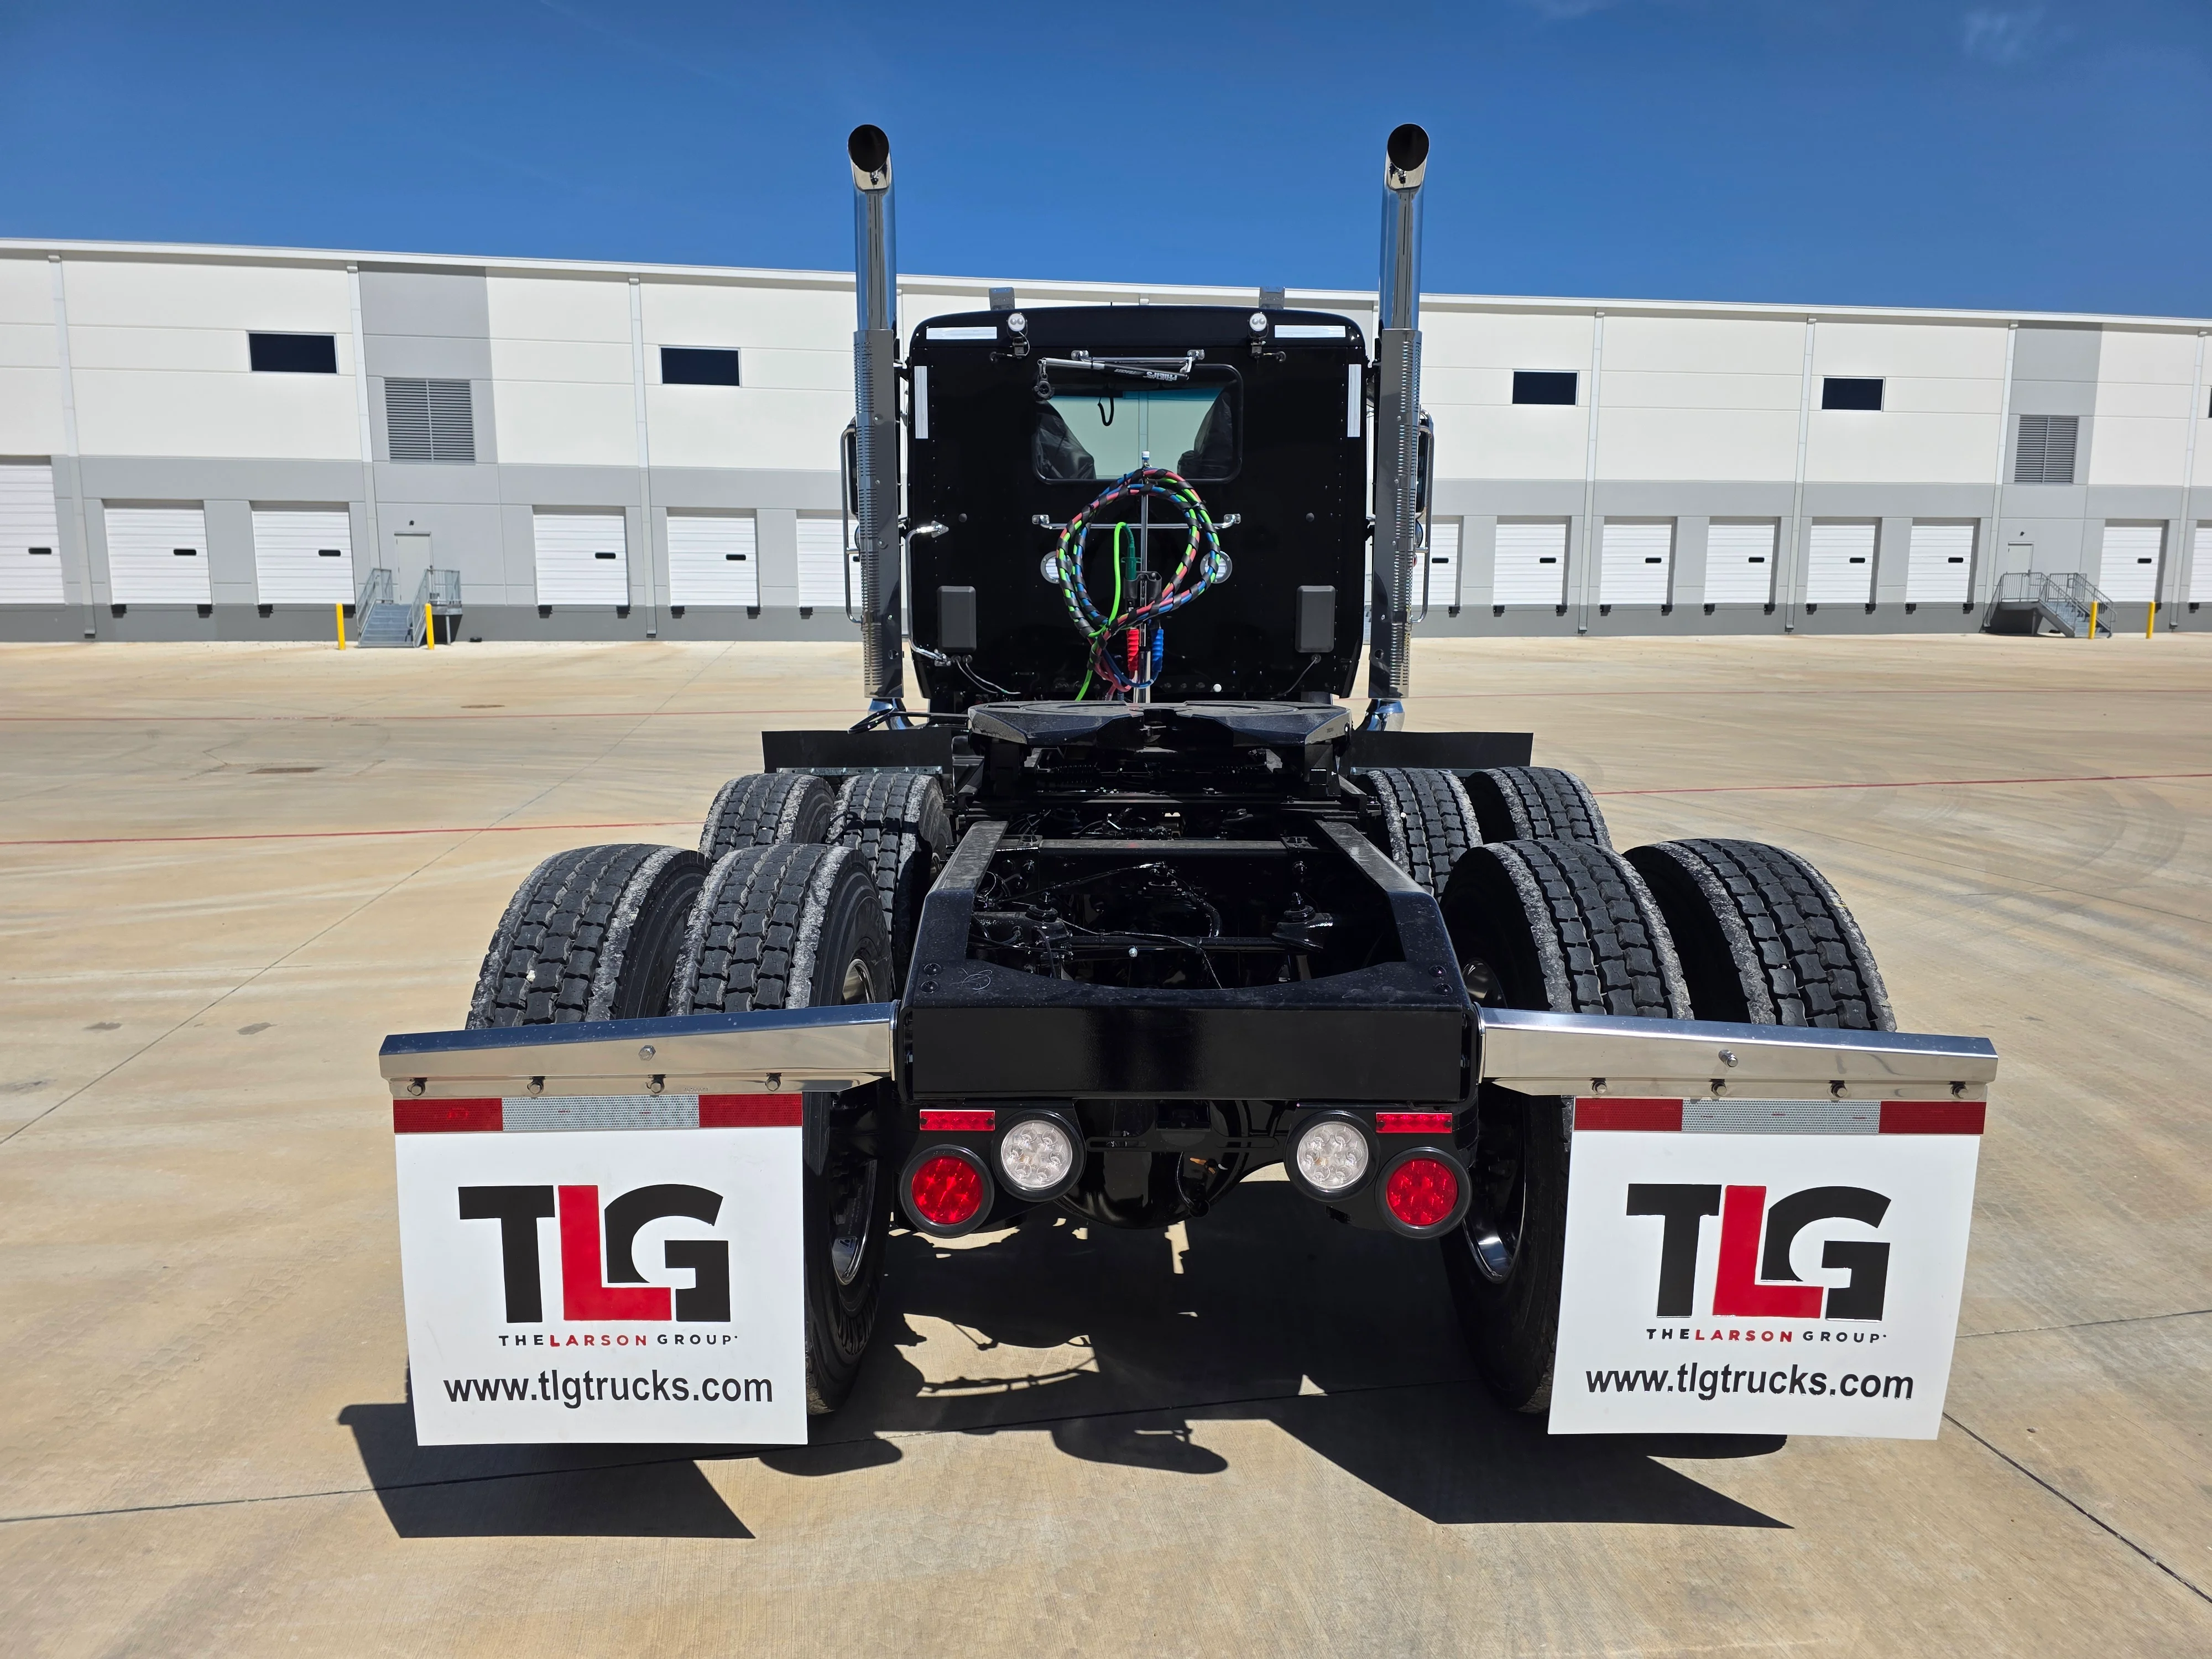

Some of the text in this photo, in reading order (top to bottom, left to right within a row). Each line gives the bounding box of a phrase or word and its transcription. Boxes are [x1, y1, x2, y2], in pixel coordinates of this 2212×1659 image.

[458, 1184, 731, 1323] TLG
[1626, 1183, 1891, 1321] TLG
[657, 1334, 732, 1345] GROUP
[1803, 1331, 1880, 1343] GROUP
[444, 1370, 773, 1409] www.tlgtrucks.com
[1586, 1363, 1913, 1401] www.tlgtrucks.com
